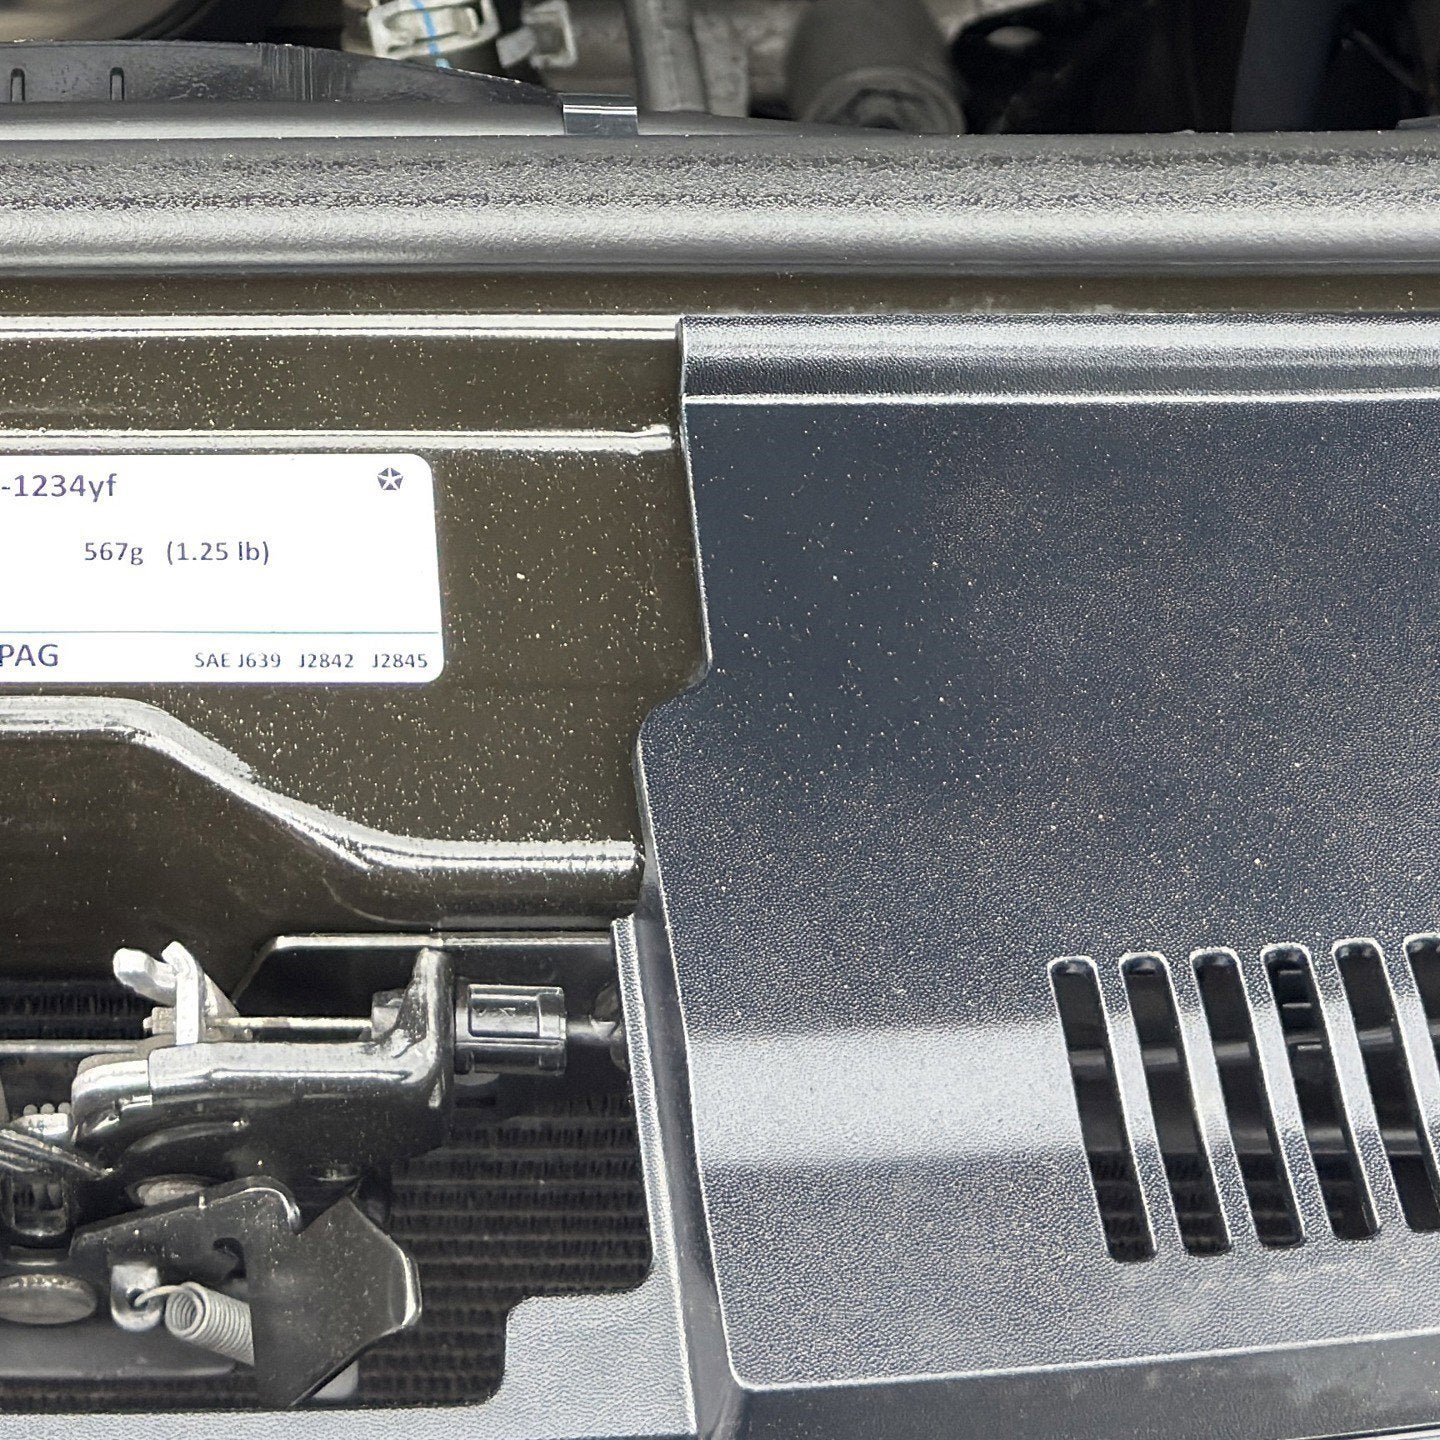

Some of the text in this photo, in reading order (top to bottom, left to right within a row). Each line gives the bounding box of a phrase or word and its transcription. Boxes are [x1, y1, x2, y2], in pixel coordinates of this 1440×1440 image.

[84, 540, 270, 567] 567g (1.25 lb)
[195, 652, 428, 669] SAE J639 J2842 J2845
